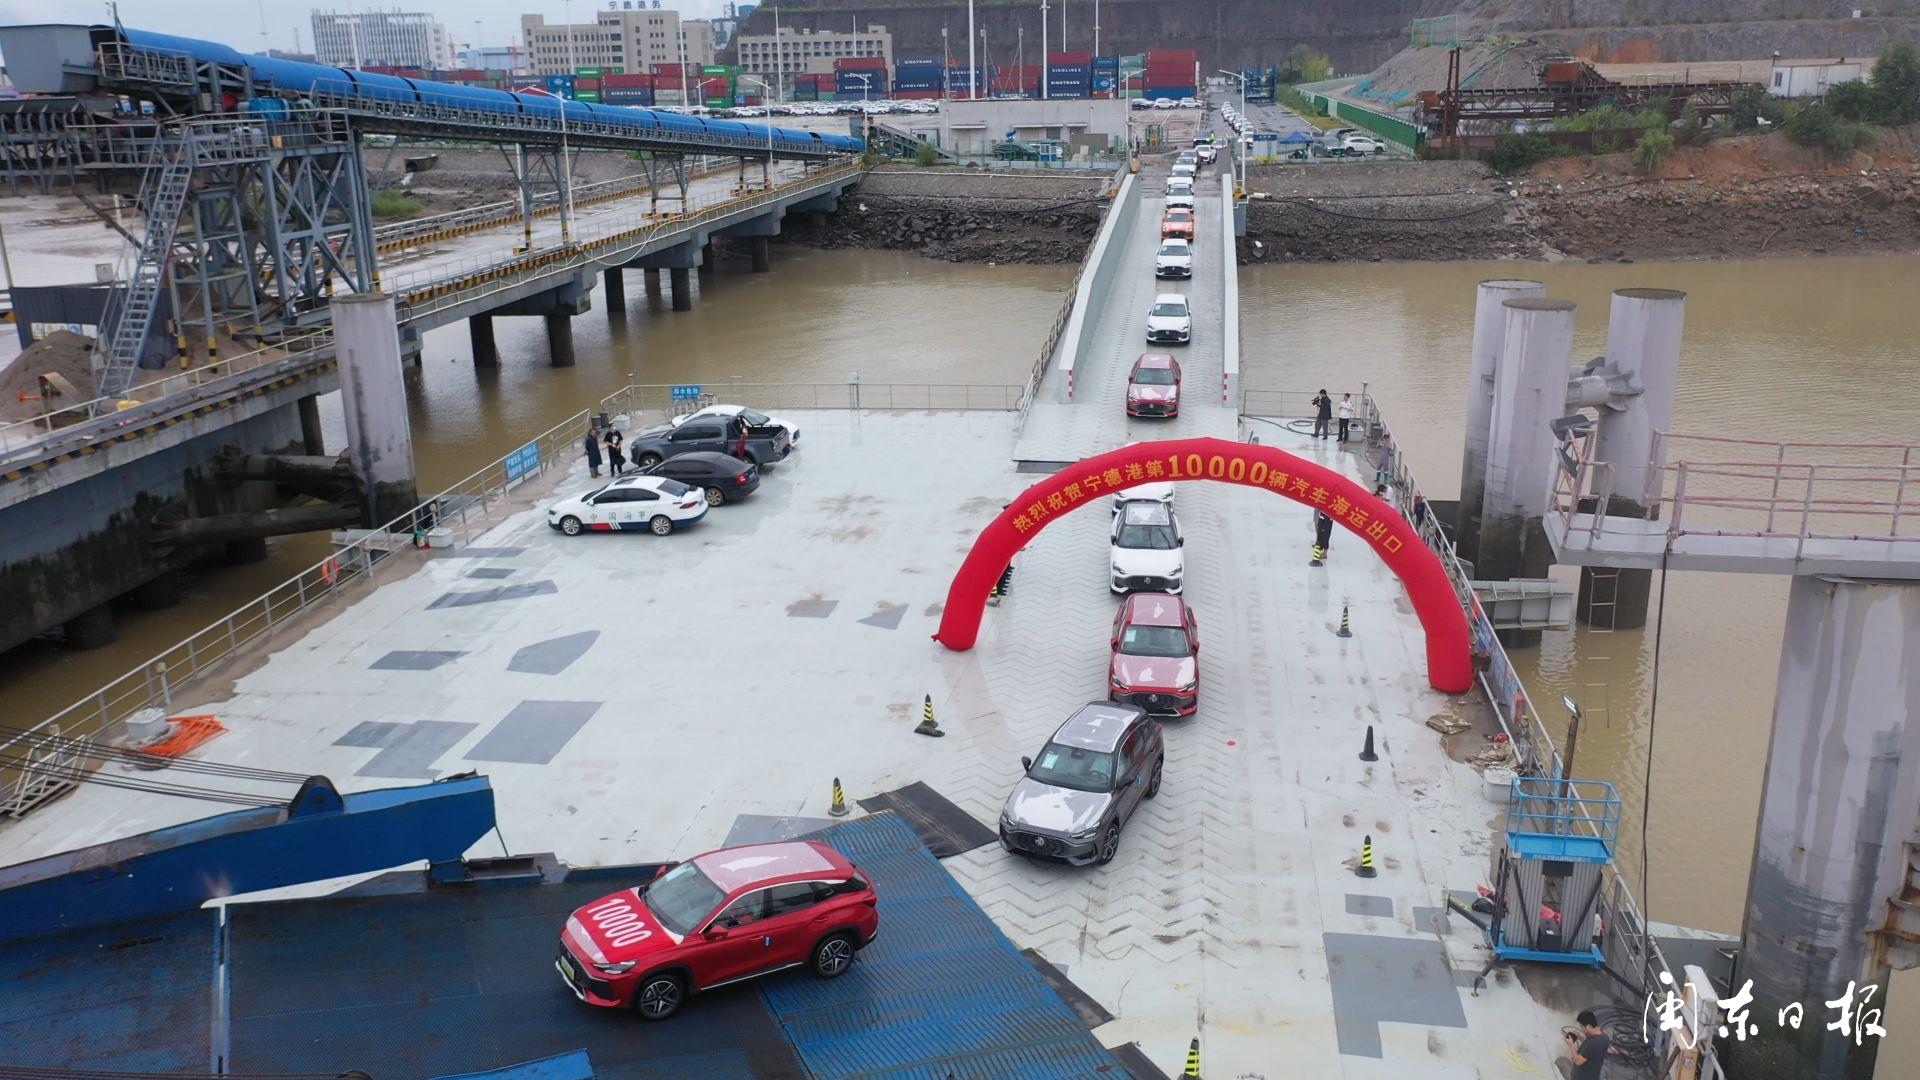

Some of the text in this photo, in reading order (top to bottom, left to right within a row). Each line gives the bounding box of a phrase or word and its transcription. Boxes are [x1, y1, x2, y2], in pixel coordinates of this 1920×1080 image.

[590, 511, 647, 523] 中国海事
[1012, 453, 1404, 555] 热烈祝贺宁德港第10000辆汽车海运出口
[587, 898, 653, 948] 10000
